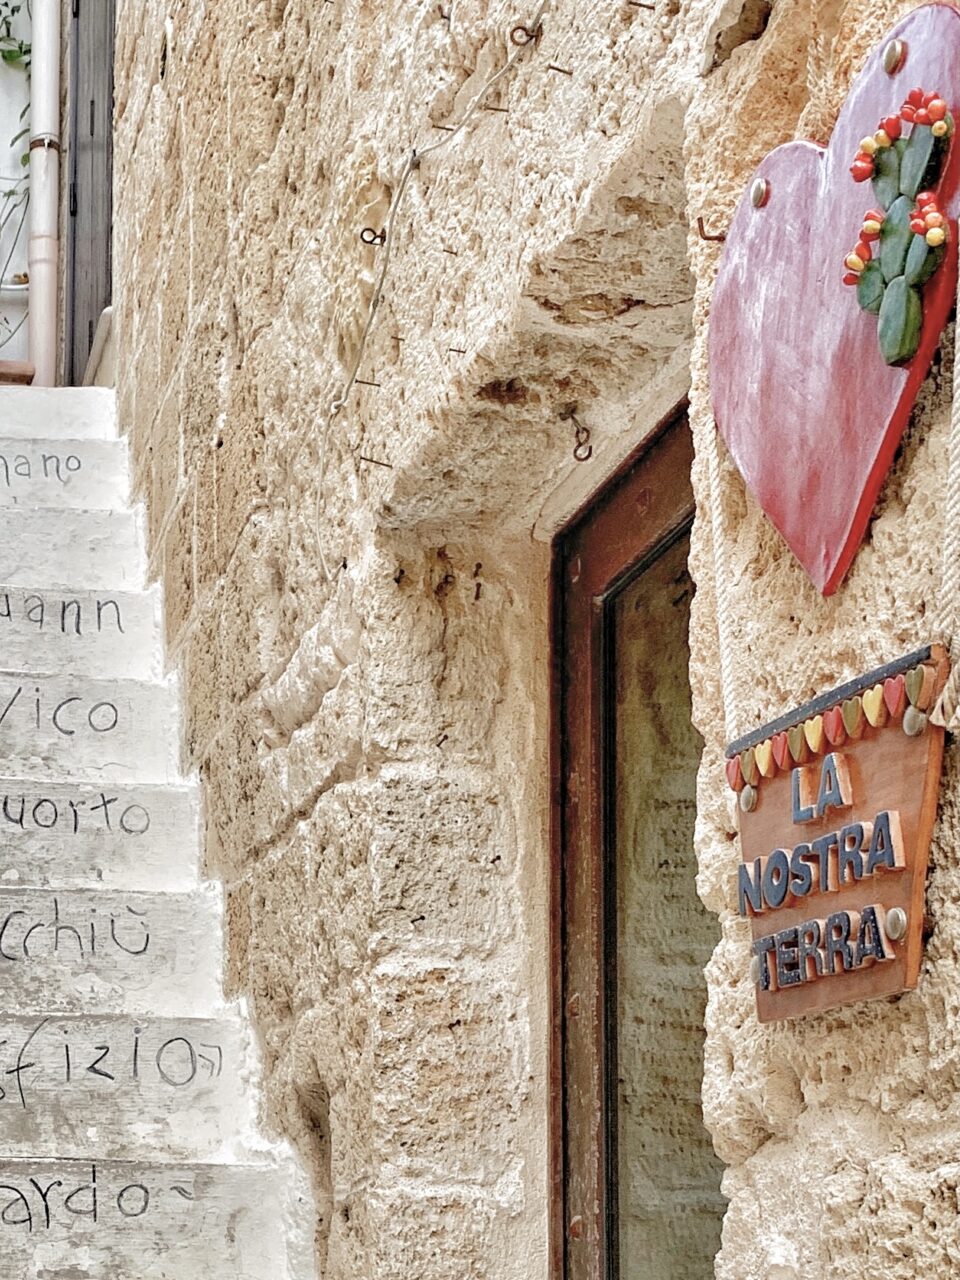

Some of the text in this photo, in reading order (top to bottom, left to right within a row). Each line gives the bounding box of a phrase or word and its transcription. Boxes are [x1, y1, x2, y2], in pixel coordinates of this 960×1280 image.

[790, 752, 850, 824] LA
[738, 809, 902, 918] NOSTRA
[751, 904, 892, 992] TERRA
